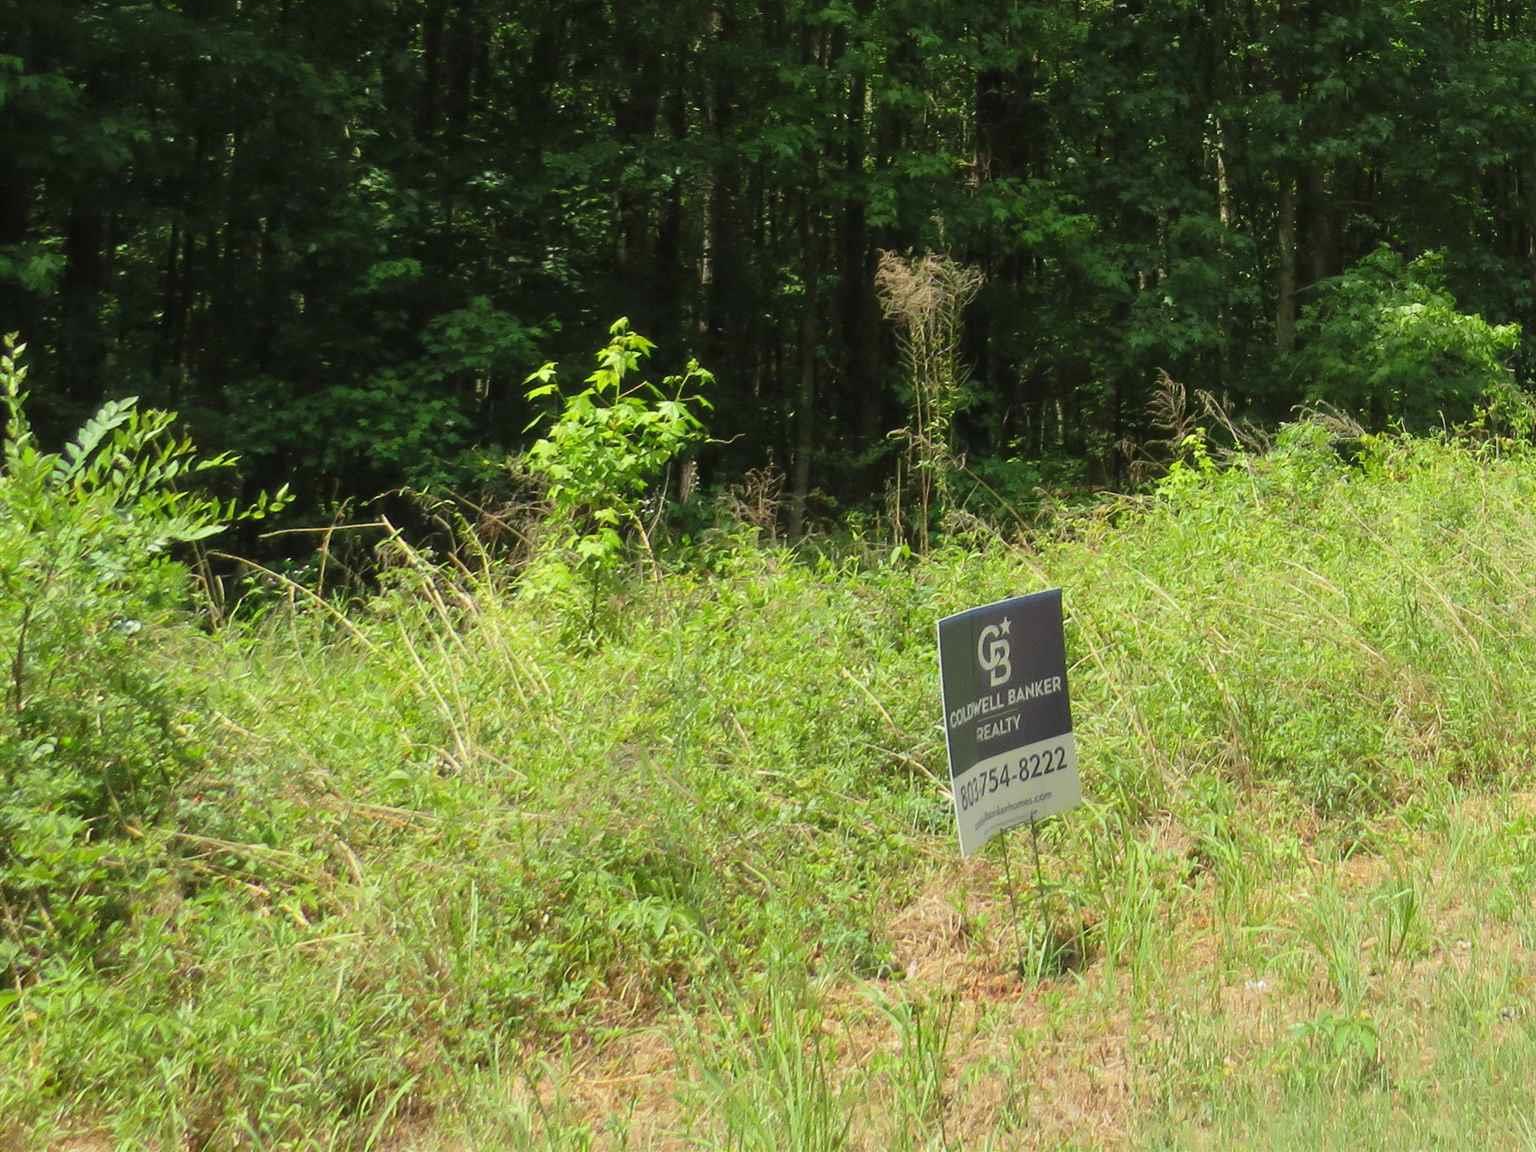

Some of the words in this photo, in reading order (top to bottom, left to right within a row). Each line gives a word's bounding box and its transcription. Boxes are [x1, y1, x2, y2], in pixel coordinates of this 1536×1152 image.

[949, 693, 1004, 728] COLDWELL
[1007, 676, 1061, 705] BANKER
[976, 713, 1021, 741] REALTY
